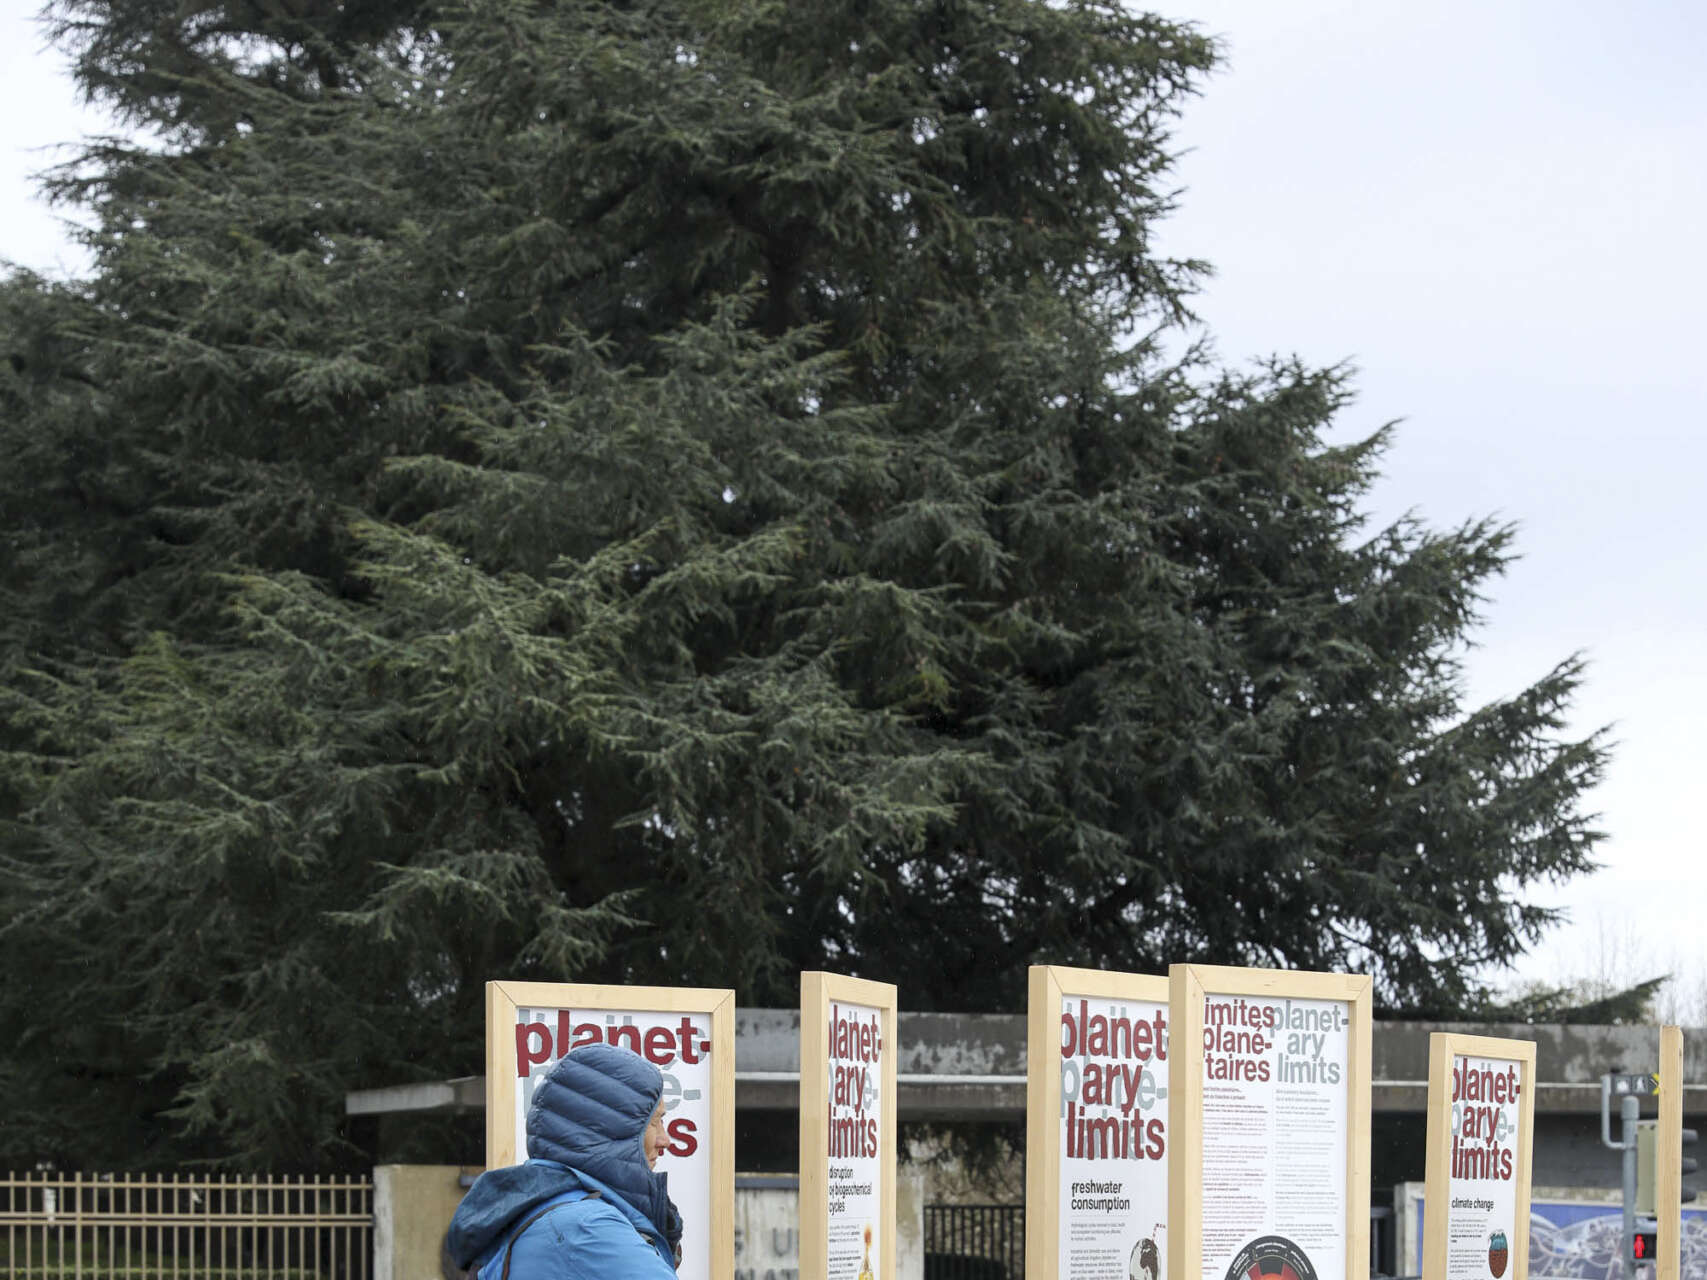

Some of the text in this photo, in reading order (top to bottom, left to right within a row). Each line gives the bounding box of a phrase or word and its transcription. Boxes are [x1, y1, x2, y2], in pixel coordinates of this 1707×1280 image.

[1204, 996, 1274, 1028] imites
[1270, 1000, 1349, 1039] planet-
[515, 1010, 711, 1078] planet-
[1203, 1023, 1272, 1057] plané-
[1287, 1032, 1326, 1060] ary
[1205, 1053, 1271, 1082] taires
[1277, 1053, 1341, 1085] limits
[835, 1065, 866, 1113] ary
[1082, 1063, 1143, 1114] ary
[828, 1102, 877, 1159] limits
[1066, 1101, 1165, 1161] limits
[1462, 1106, 1500, 1145] ary
[1451, 1135, 1513, 1181] limits
[829, 1167, 854, 1182] disruption
[835, 1183, 872, 1198] biogeochemical
[1071, 1179, 1123, 1198] freshwater
[829, 1200, 845, 1216] cycles
[1071, 1197, 1131, 1214] consumption
[1451, 1197, 1494, 1213] climate change
